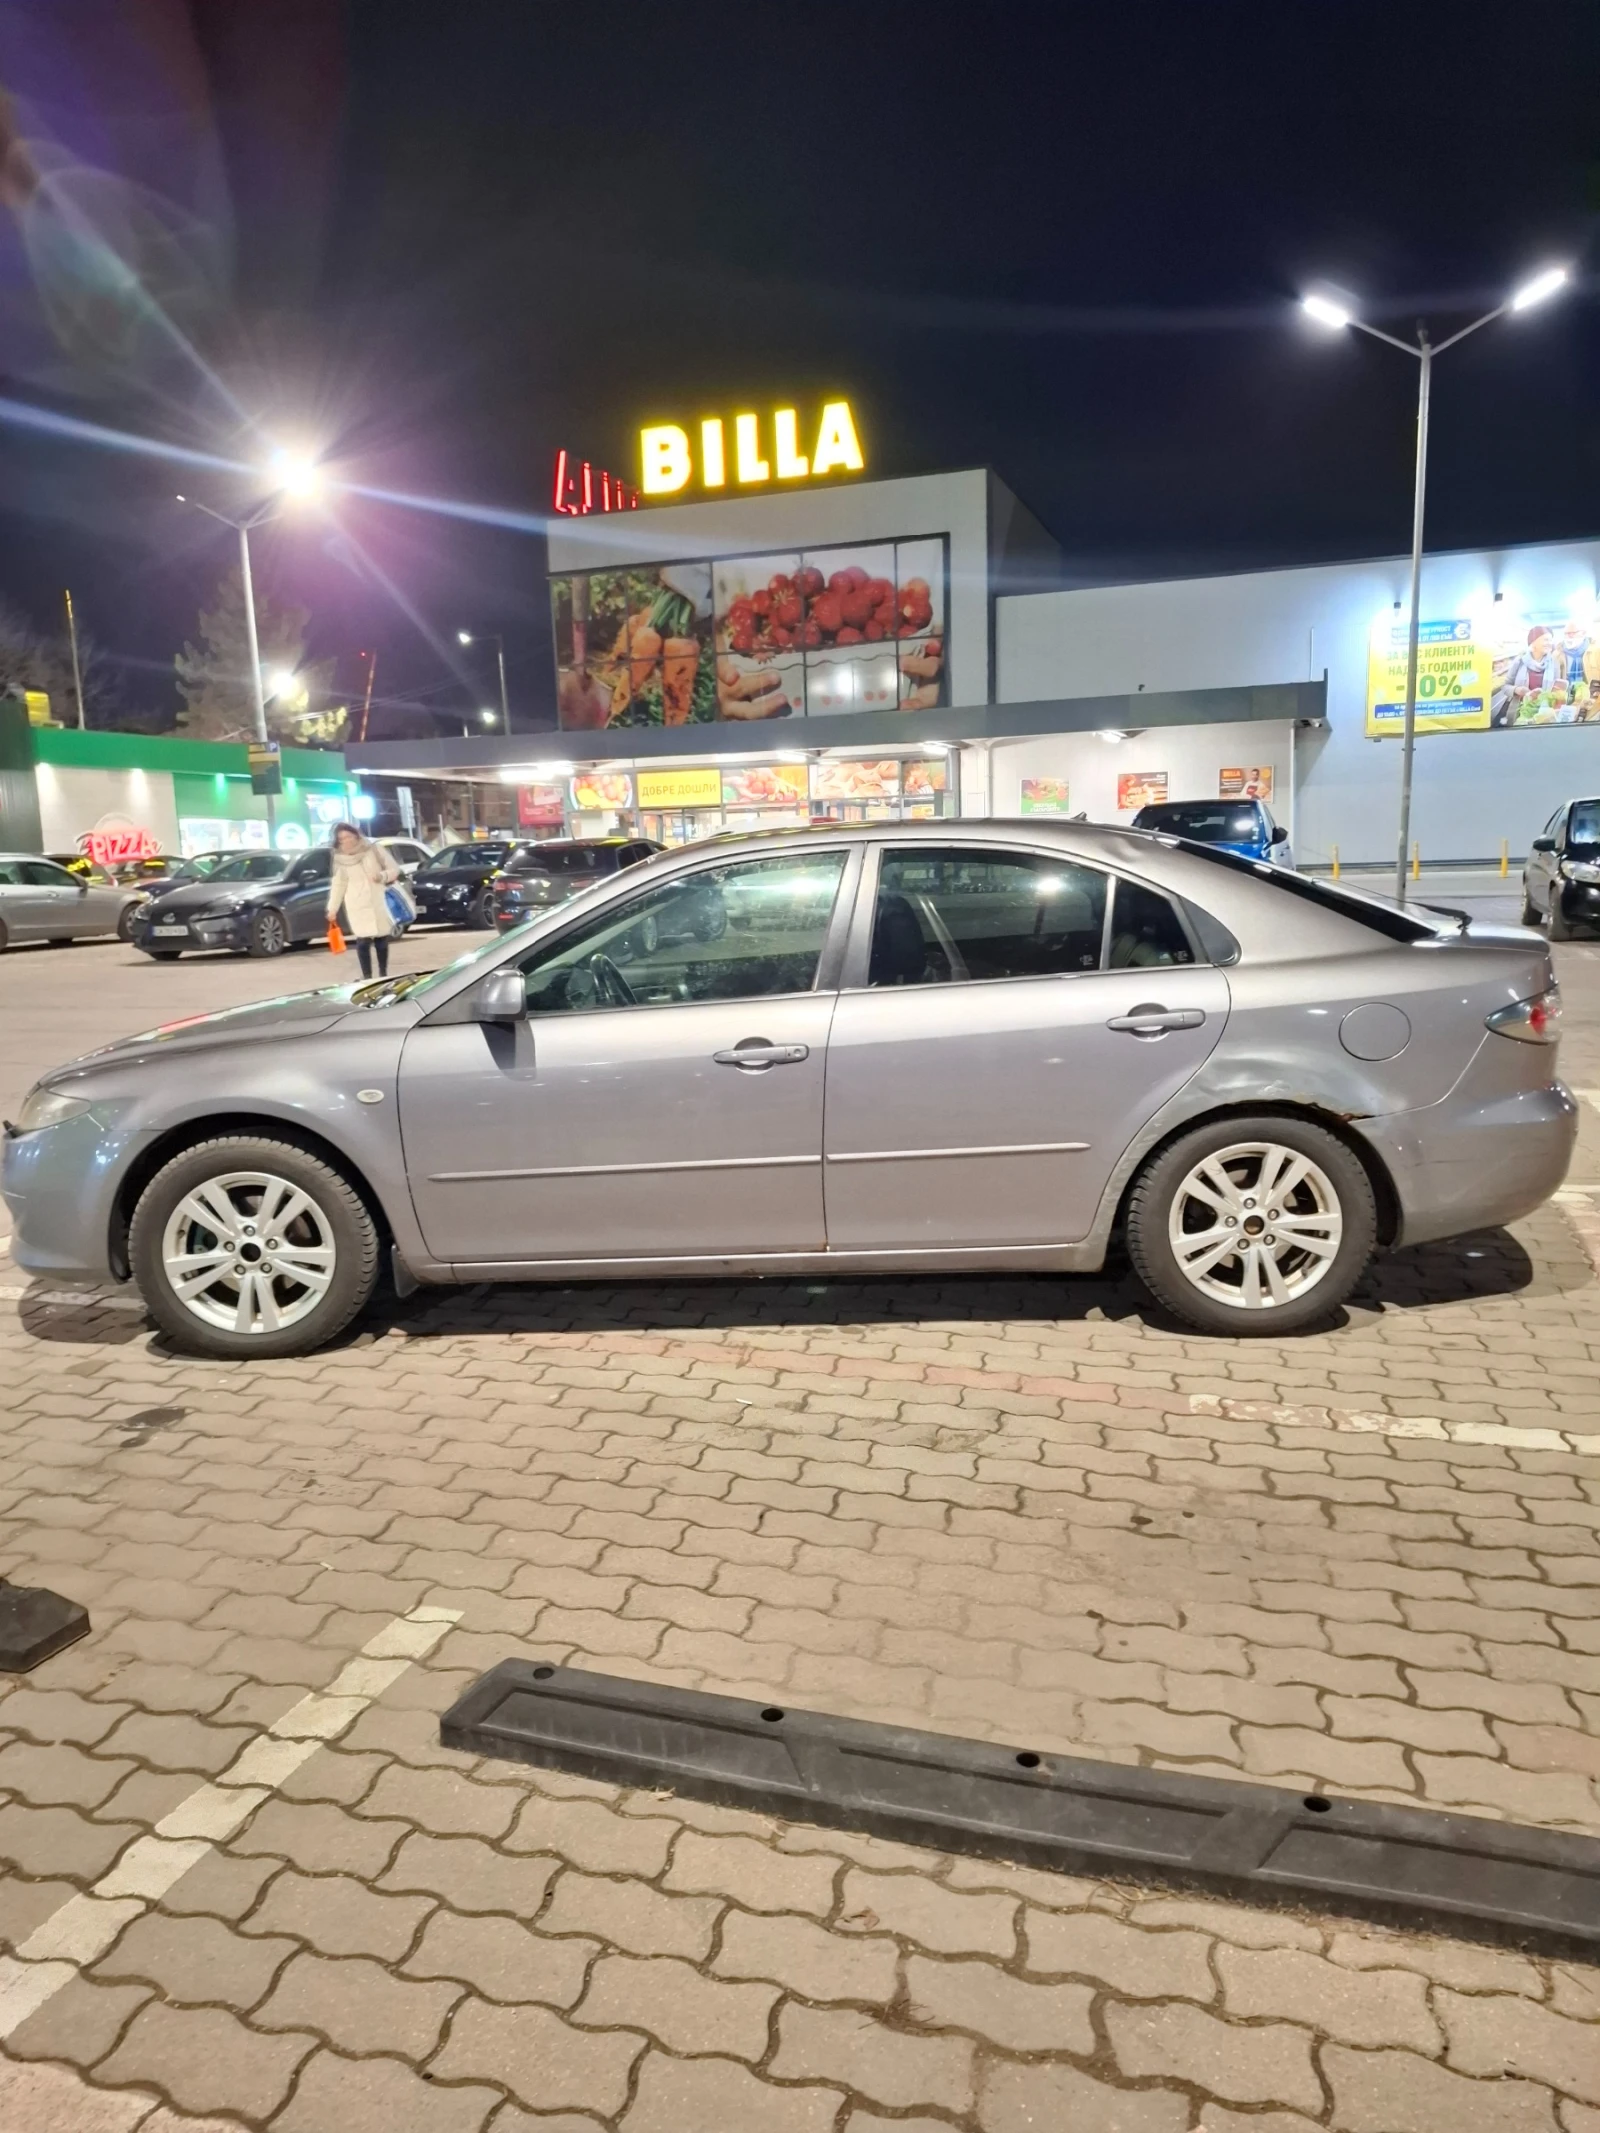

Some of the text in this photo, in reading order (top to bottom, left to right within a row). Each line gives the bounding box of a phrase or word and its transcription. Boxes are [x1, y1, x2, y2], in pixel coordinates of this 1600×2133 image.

[640, 401, 865, 494] BILLA
[1425, 645, 1475, 658] КЛИЕНТИ
[1428, 660, 1472, 673] ГОДИНИ
[642, 783, 717, 797] ДОБРЕ ДОШЛИ
[91, 831, 156, 864] PIZZA
